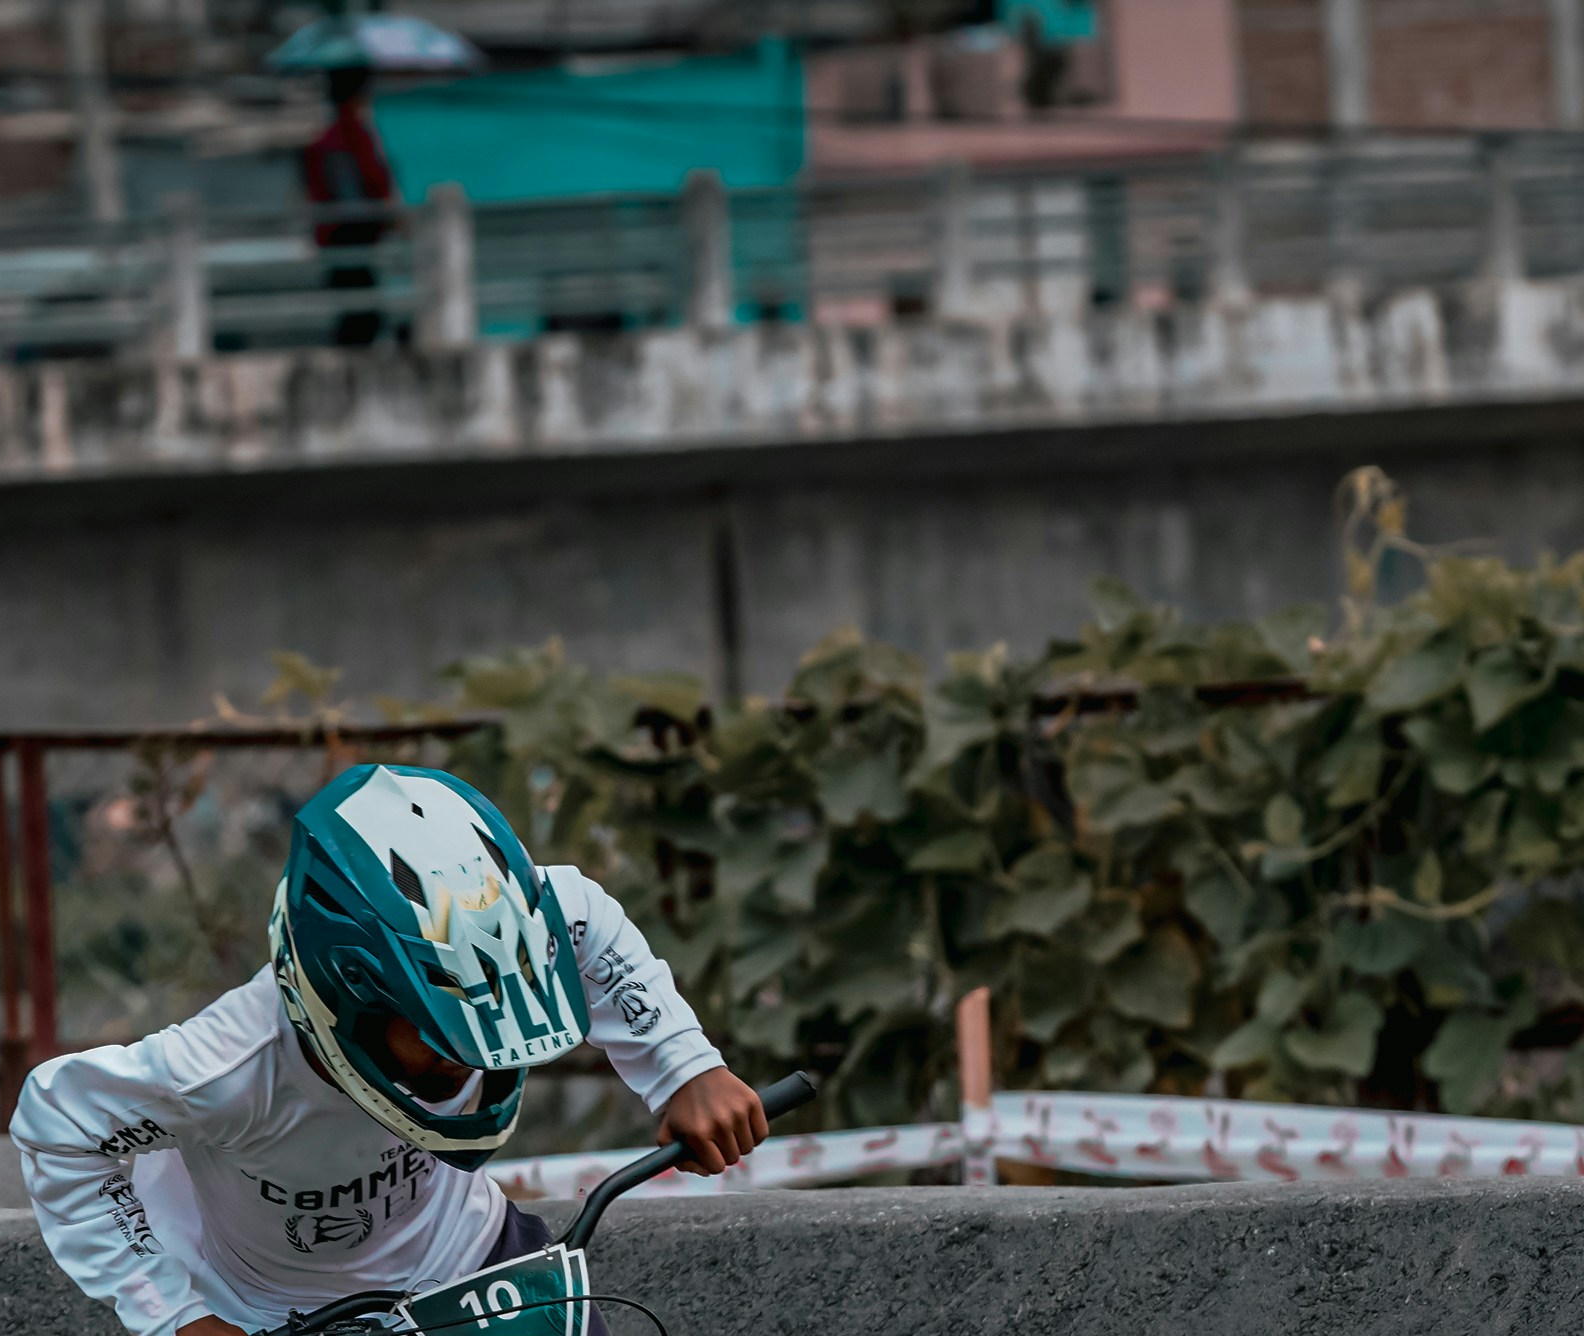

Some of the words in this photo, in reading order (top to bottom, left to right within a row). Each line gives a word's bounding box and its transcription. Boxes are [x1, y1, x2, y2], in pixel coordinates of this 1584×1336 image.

[465, 964, 568, 1052] FLY
[491, 1032, 576, 1068] RACING
[458, 1280, 523, 1330] 10
